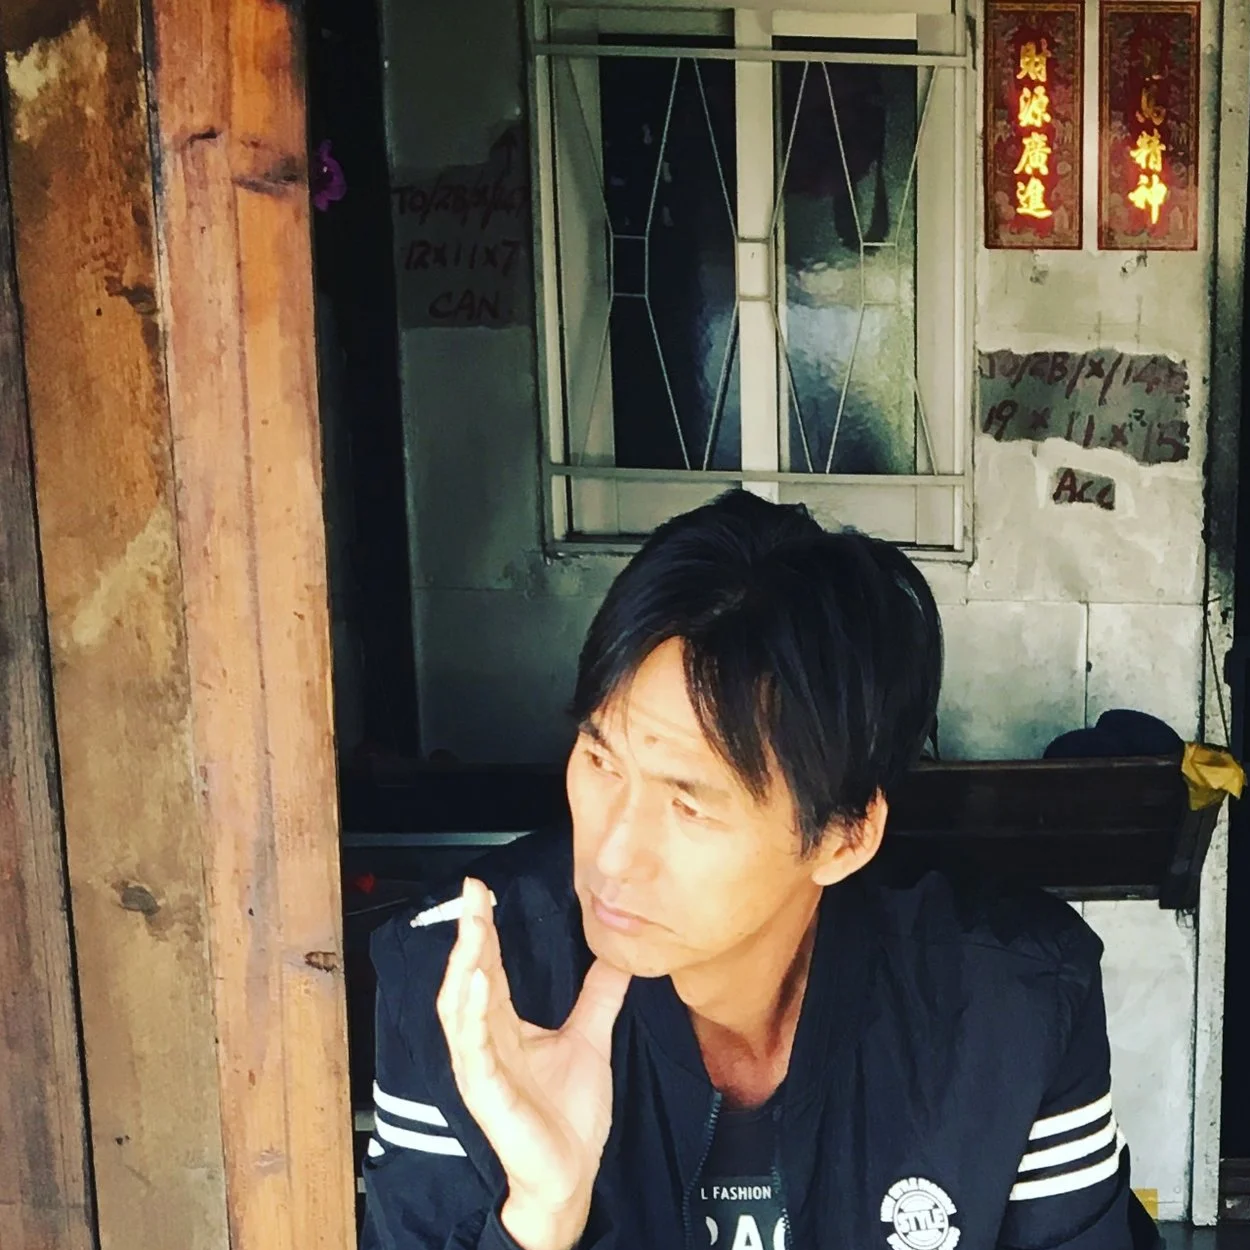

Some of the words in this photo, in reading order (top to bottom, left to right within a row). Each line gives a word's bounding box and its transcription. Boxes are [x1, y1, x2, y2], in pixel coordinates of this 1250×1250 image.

[1014, 38, 1053, 220] 財源廣進
[428, 289, 500, 321] CAN
[712, 1185, 772, 1201] FASHION
[897, 1207, 947, 1233] STYLE
